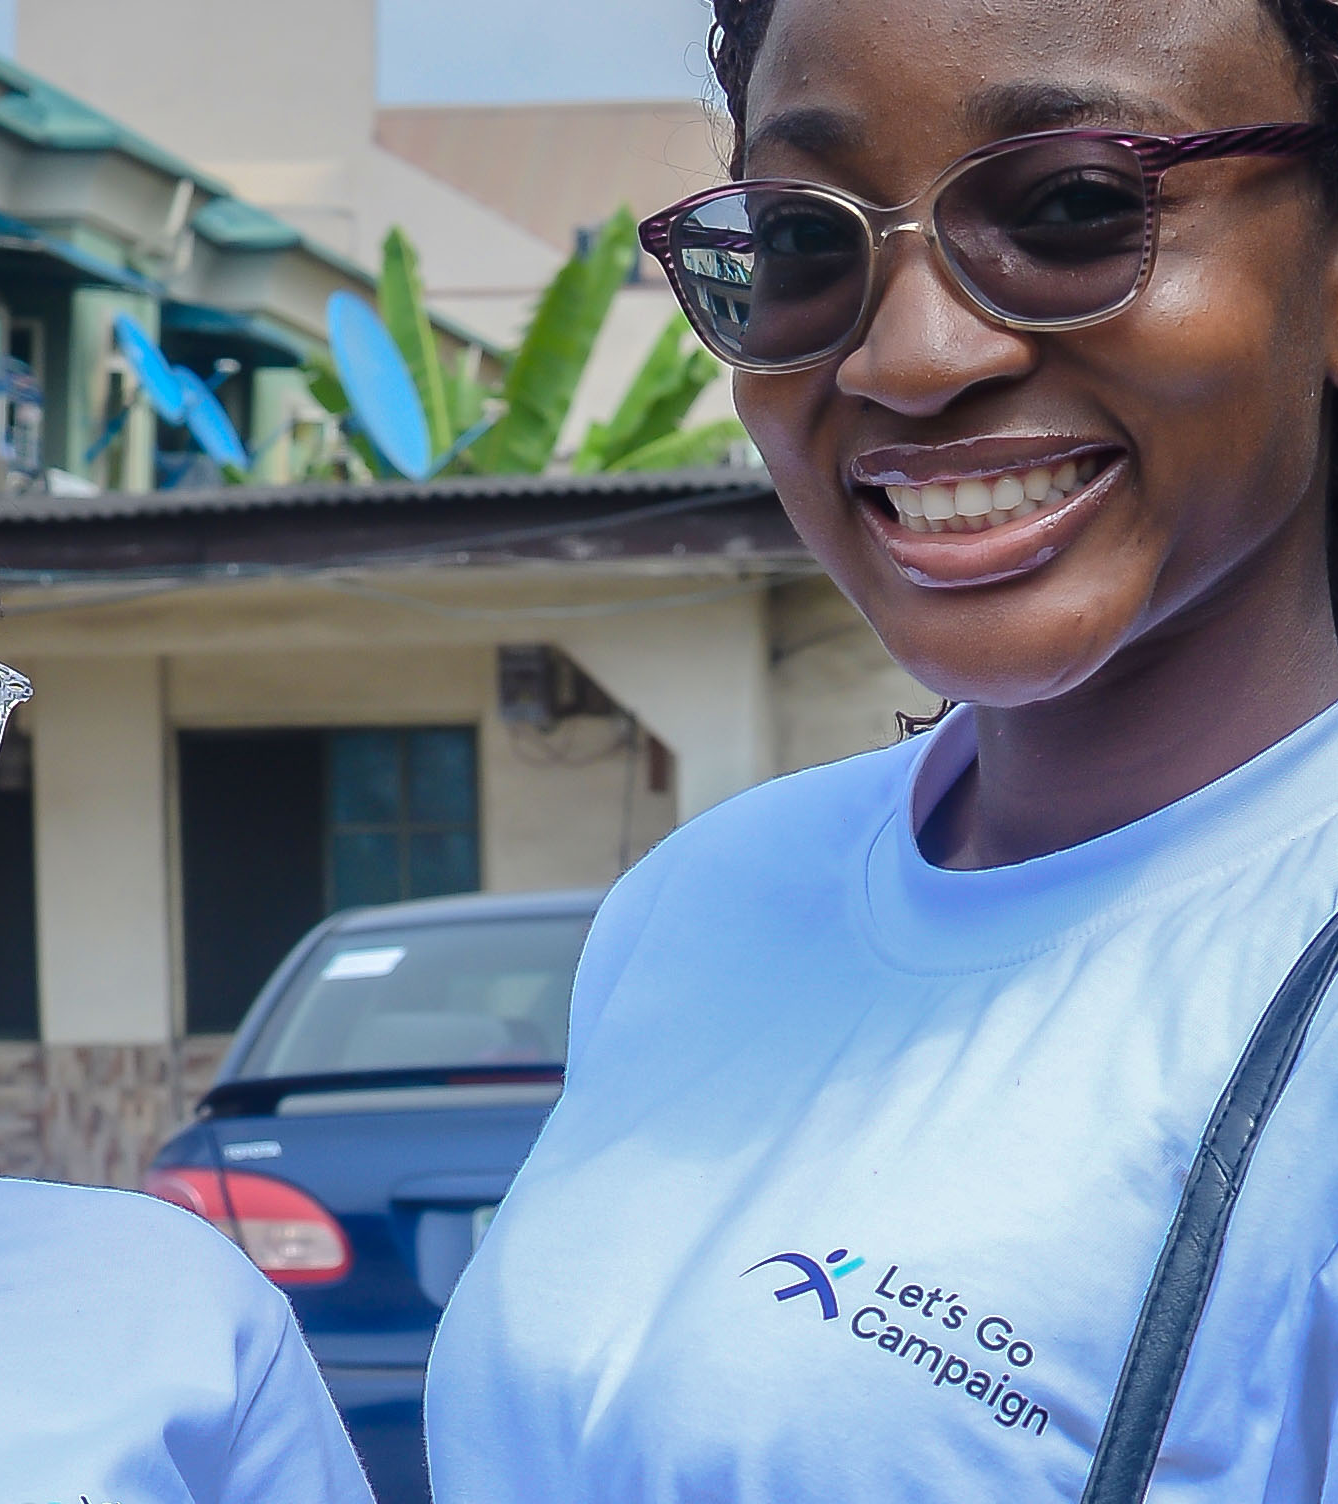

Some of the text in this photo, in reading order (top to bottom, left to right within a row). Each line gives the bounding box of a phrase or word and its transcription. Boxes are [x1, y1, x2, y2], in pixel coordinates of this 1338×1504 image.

[851, 1306, 1050, 1436] Campaign
[875, 1265, 1034, 1368] Let's Go
